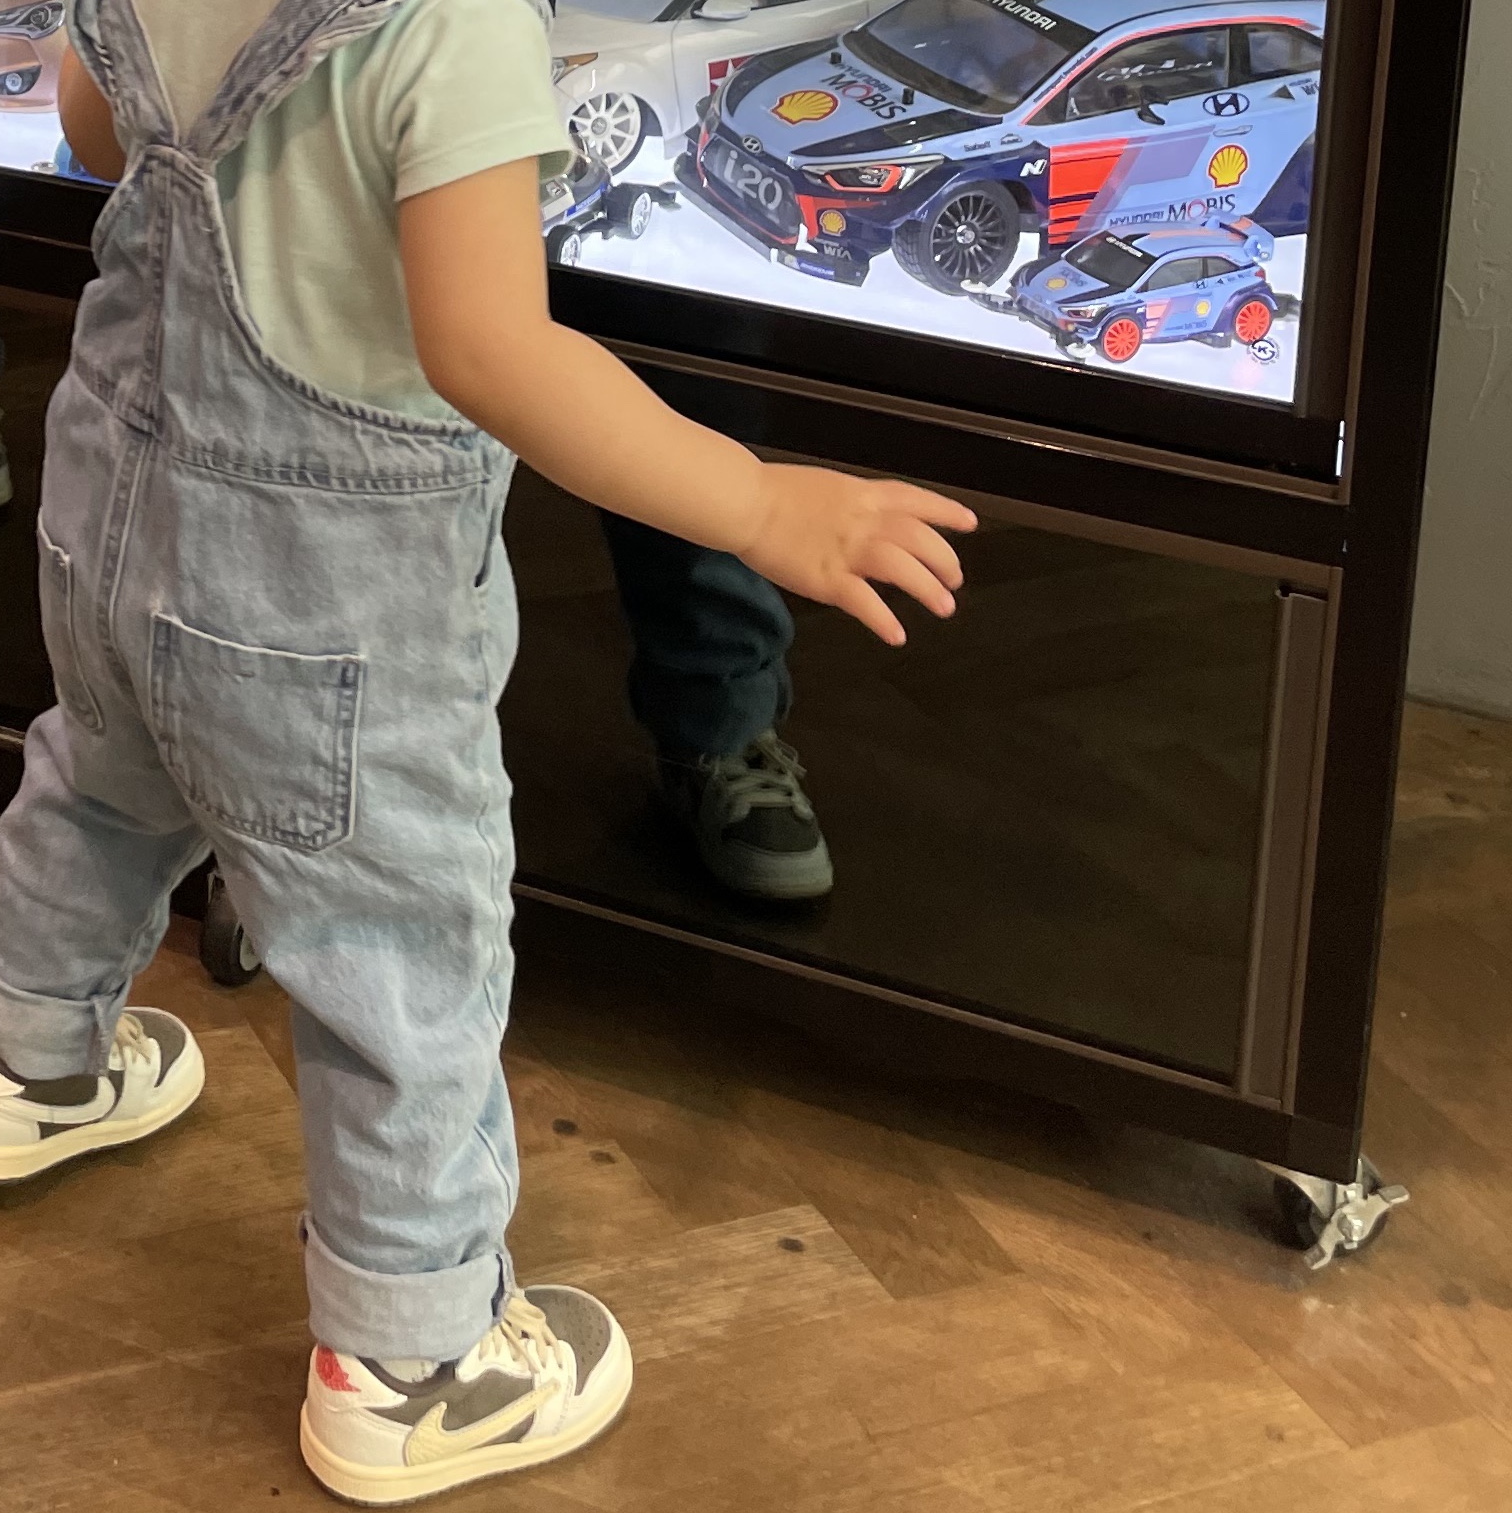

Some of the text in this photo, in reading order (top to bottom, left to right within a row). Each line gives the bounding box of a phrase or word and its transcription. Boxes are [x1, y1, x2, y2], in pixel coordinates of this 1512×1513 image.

[821, 73, 906, 120] MOBIS
[723, 150, 783, 210] i20
[1109, 194, 1236, 228] HYUNDAI MOBIS
